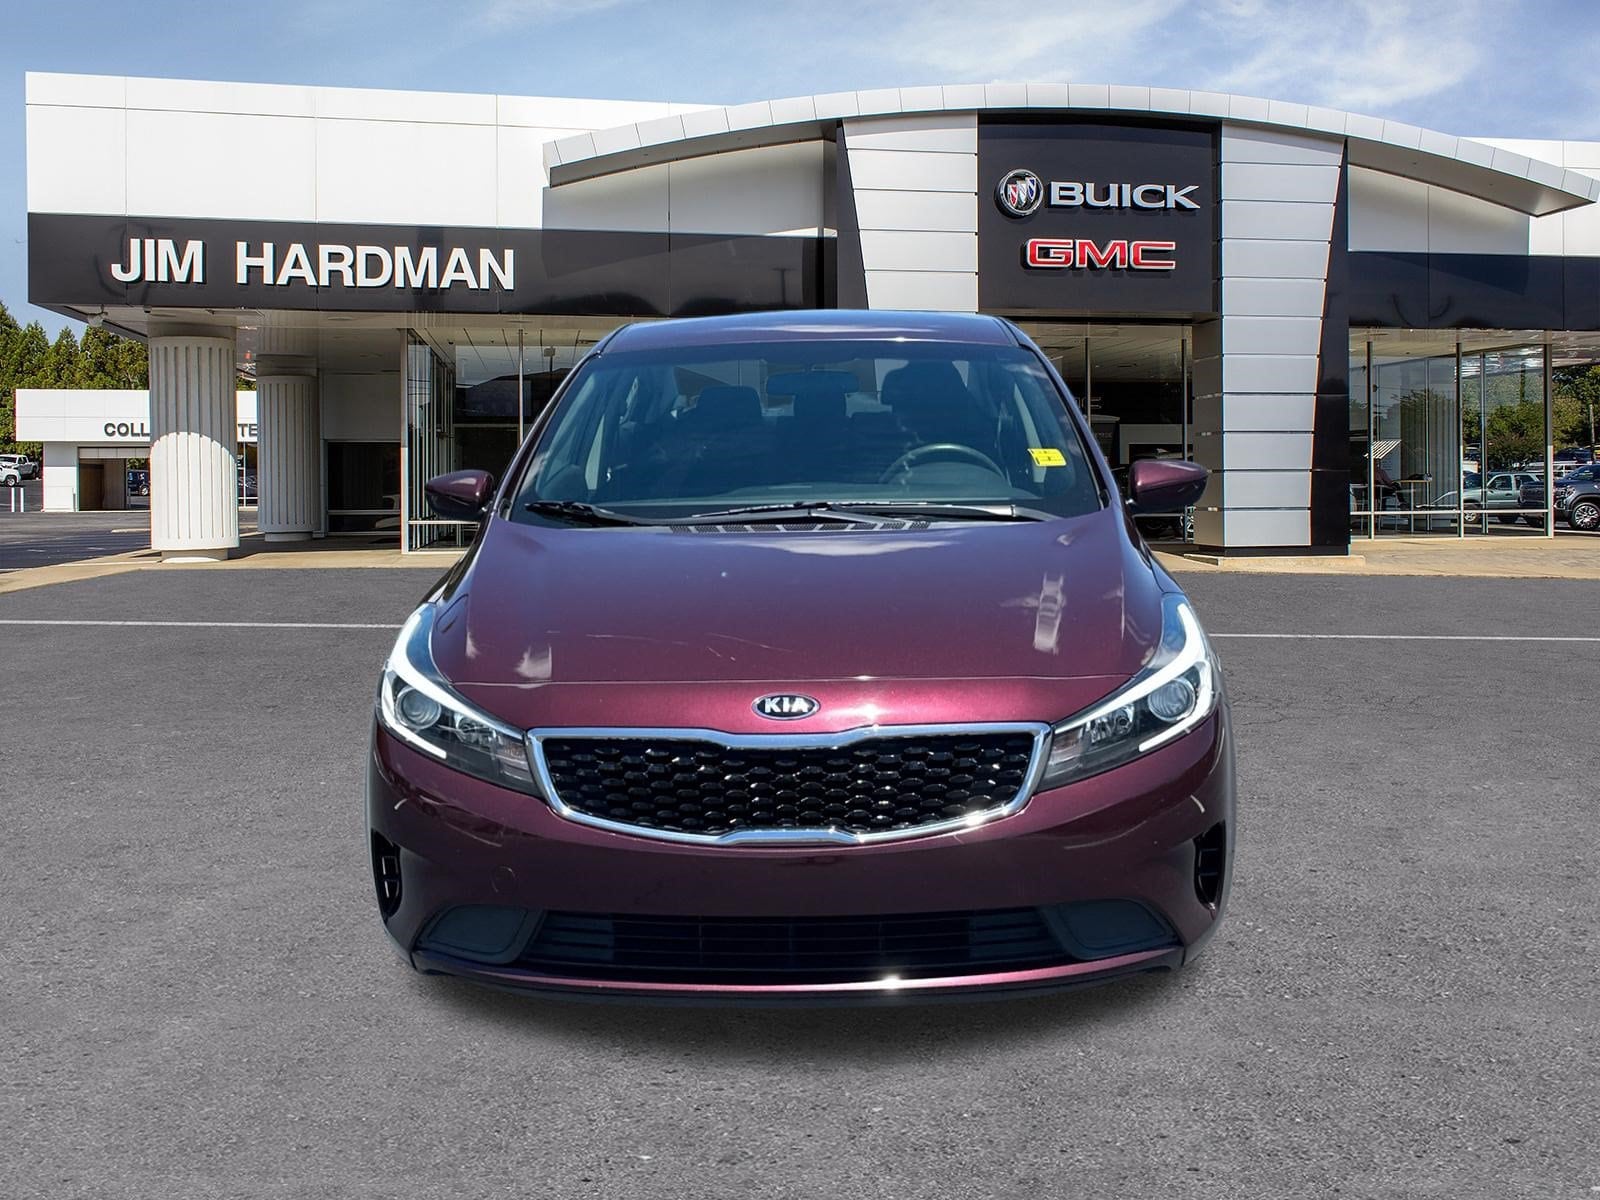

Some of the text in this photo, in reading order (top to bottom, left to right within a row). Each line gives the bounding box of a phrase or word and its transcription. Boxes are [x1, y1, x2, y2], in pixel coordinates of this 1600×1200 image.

[1050, 181, 1200, 209] BUICK
[111, 238, 515, 290] JIM HARDMAN
[1026, 238, 1176, 270] GMC
[764, 697, 810, 713] KIA
